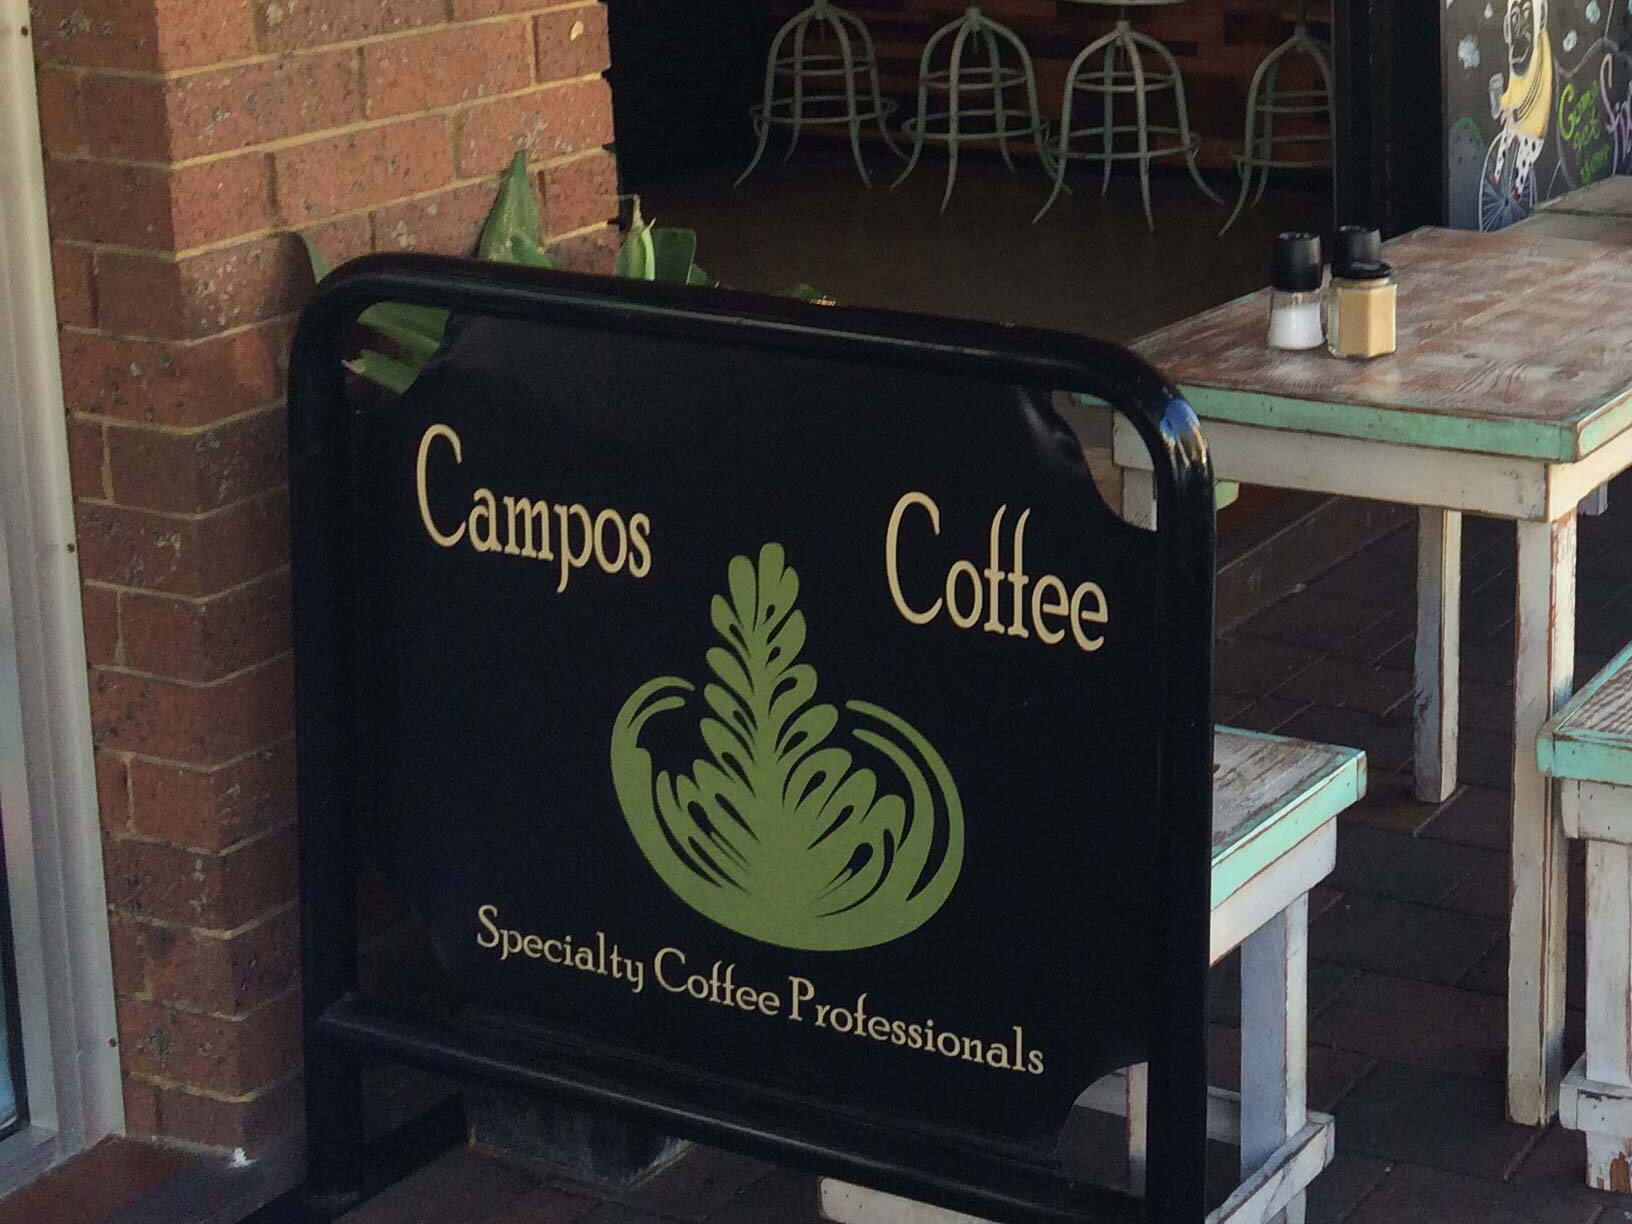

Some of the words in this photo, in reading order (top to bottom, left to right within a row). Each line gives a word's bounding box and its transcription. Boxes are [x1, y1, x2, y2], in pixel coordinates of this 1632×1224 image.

[415, 423, 653, 594] Campos
[885, 490, 1110, 651] Coffee
[476, 903, 645, 993] Specialty
[654, 947, 780, 1016] Coffee
[788, 975, 1045, 1075] Professionals
